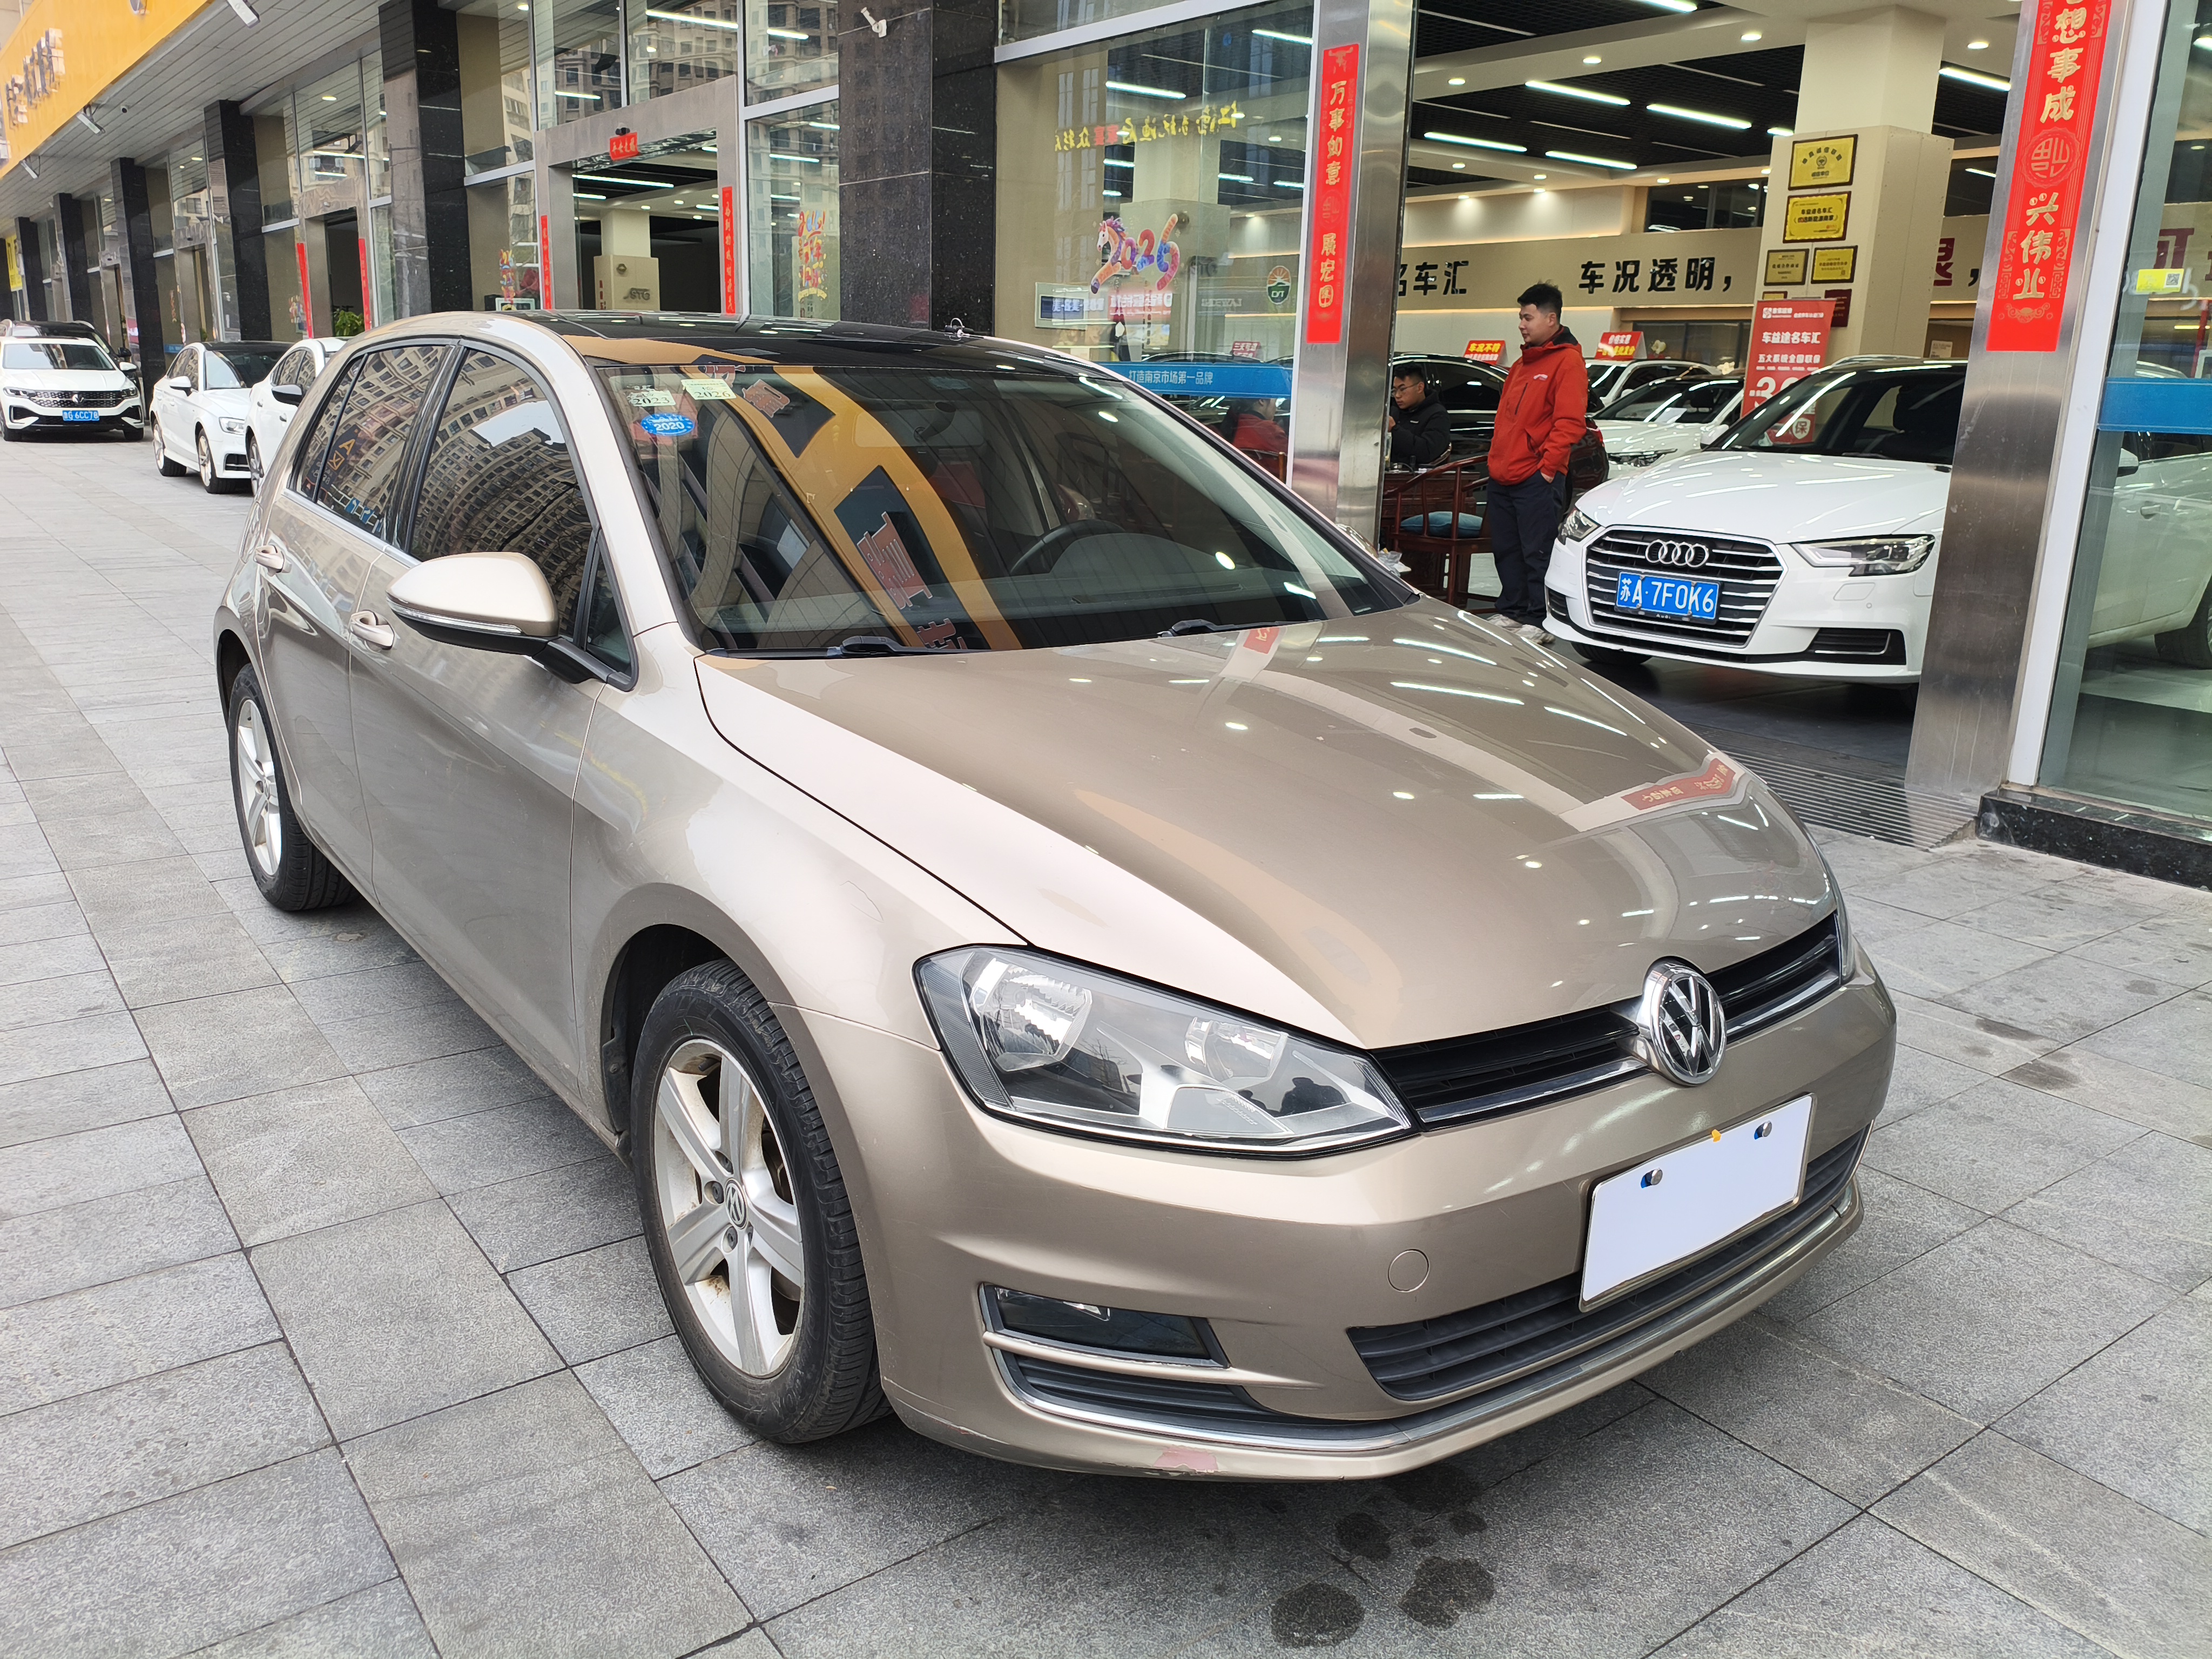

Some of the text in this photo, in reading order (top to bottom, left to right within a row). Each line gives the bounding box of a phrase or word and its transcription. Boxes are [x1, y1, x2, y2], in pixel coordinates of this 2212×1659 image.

[2013, 0, 2087, 300] 想事成 兴伟业
[1318, 80, 1347, 308] 万事如意 展宏图
[1578, 257, 1732, 294] 车况透明，
[1128, 369, 1213, 386] 打造南京市场第一品牌
[653, 421, 685, 431] 2020
